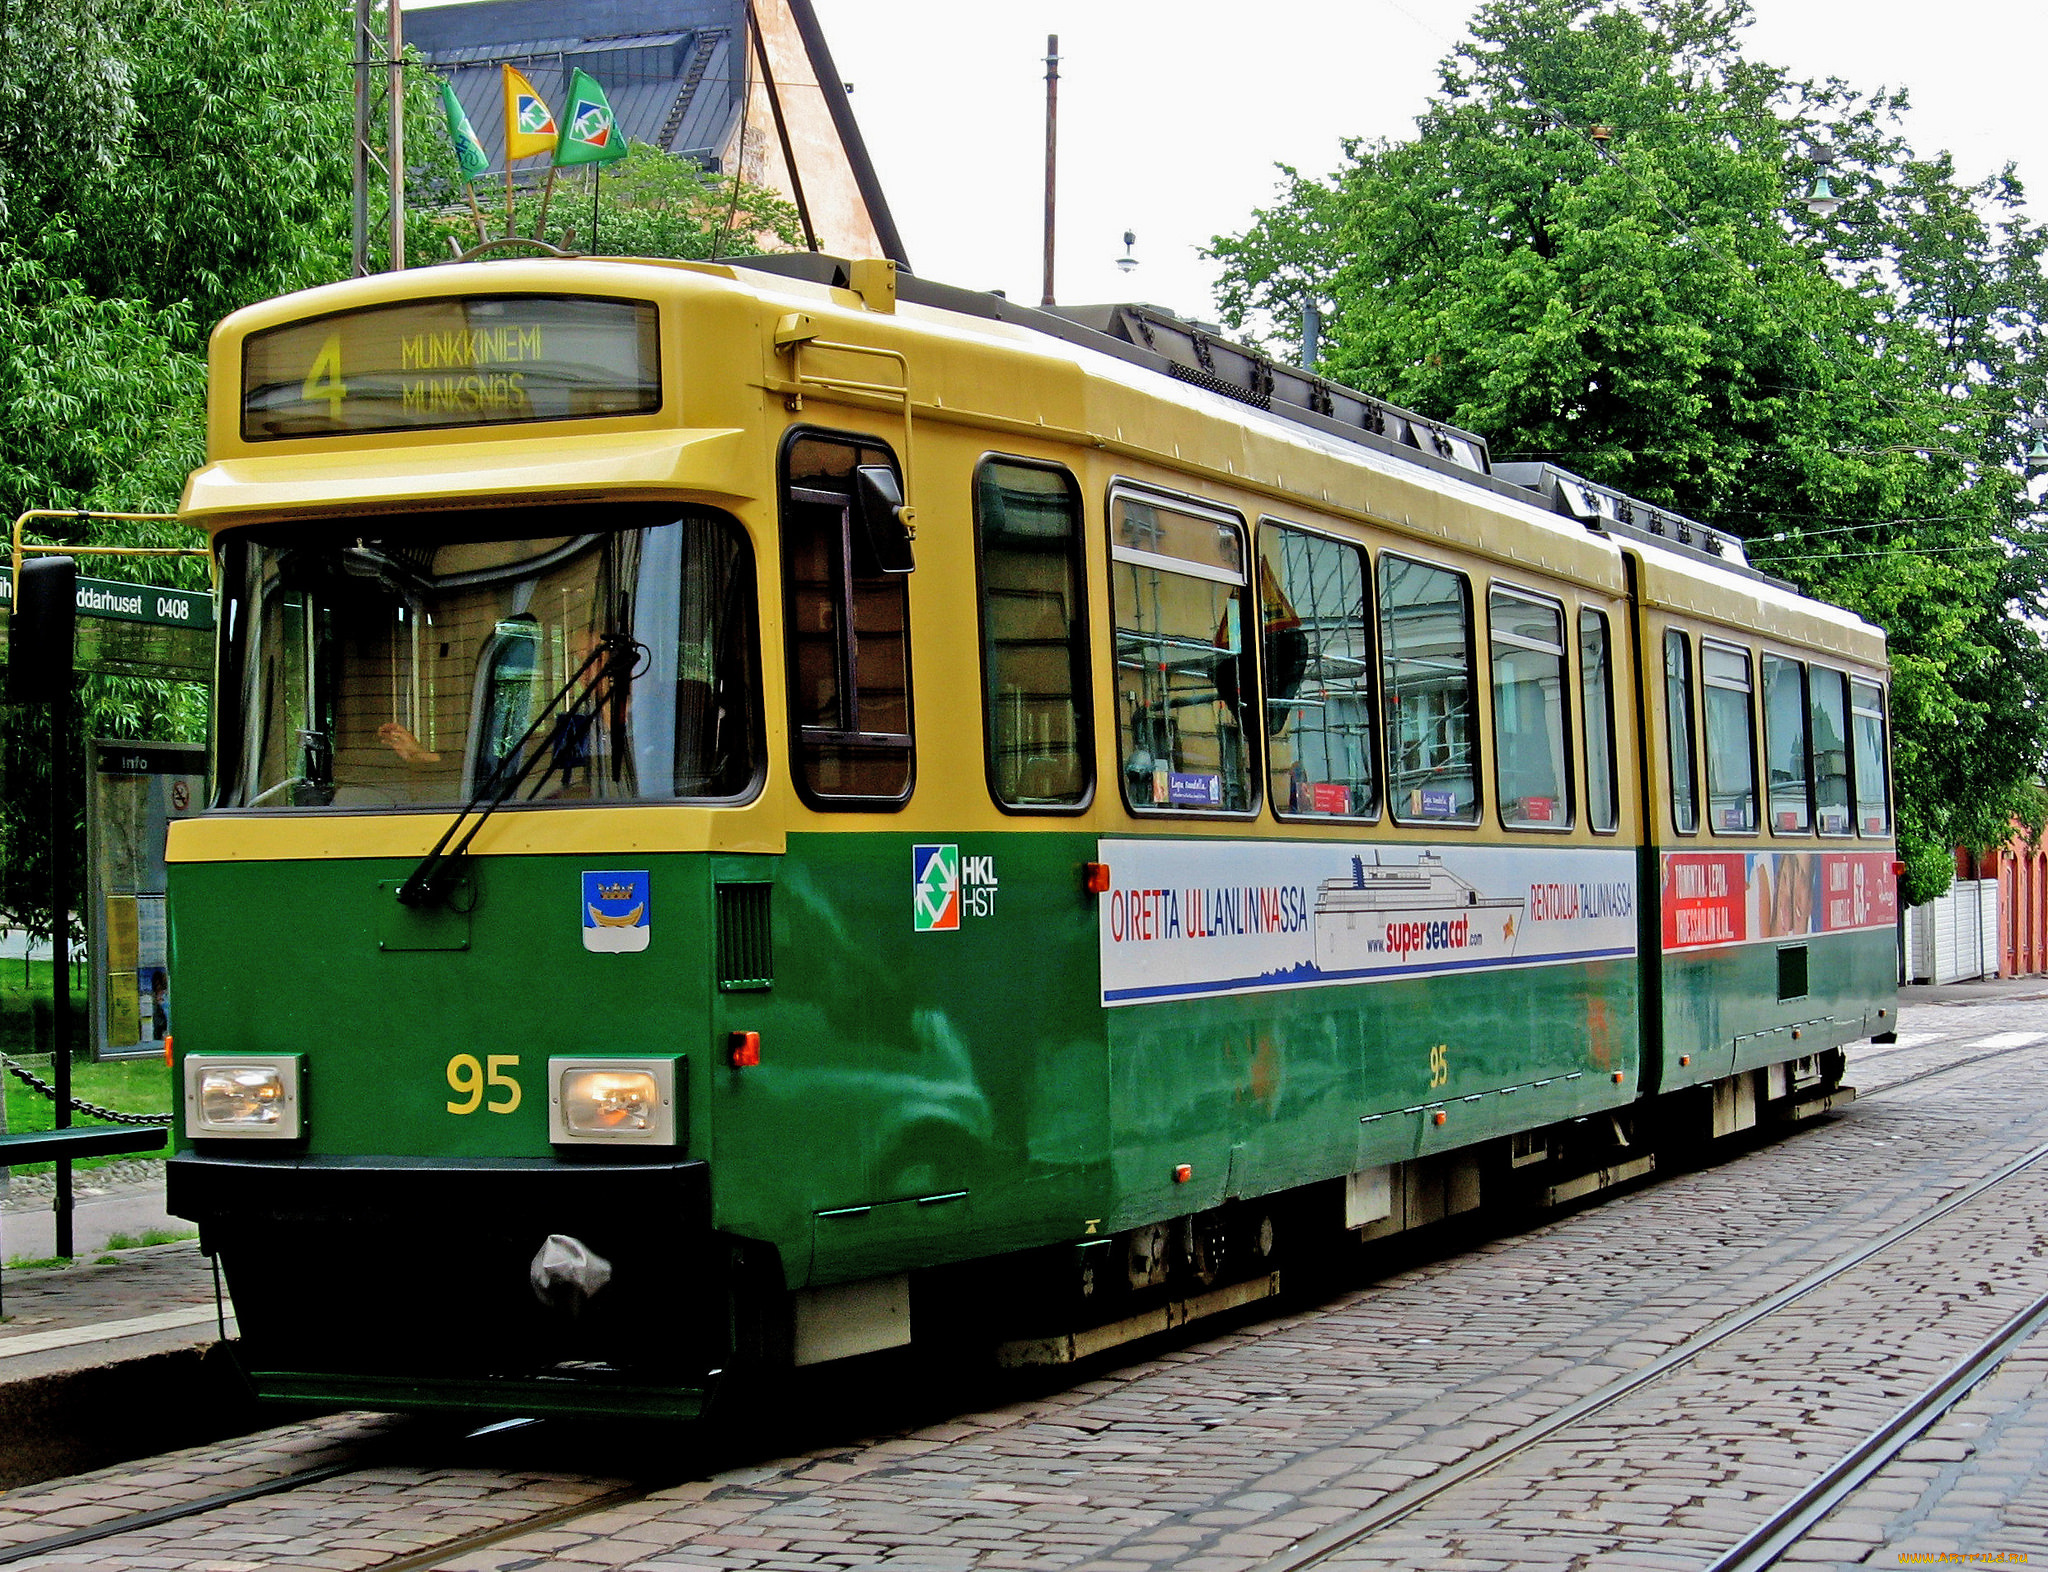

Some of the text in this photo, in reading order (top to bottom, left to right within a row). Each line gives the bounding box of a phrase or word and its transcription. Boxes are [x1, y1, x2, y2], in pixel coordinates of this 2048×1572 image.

[402, 324, 541, 369] MUNKKINIEMI
[301, 332, 347, 419] 4
[402, 372, 525, 415] MUNKSNÄS
[76, 586, 189, 620] ddarhuset 0408
[961, 856, 998, 885] HKL
[962, 887, 998, 917] HST
[1110, 886, 1308, 943] OIRETTA ULLANLINNASSA
[1530, 882, 1633, 921] RENTOILUA TALLINNASSA
[1366, 913, 1483, 962] www.superseacat.com
[446, 1053, 522, 1115] 95
[1430, 1044, 1448, 1088] 95
